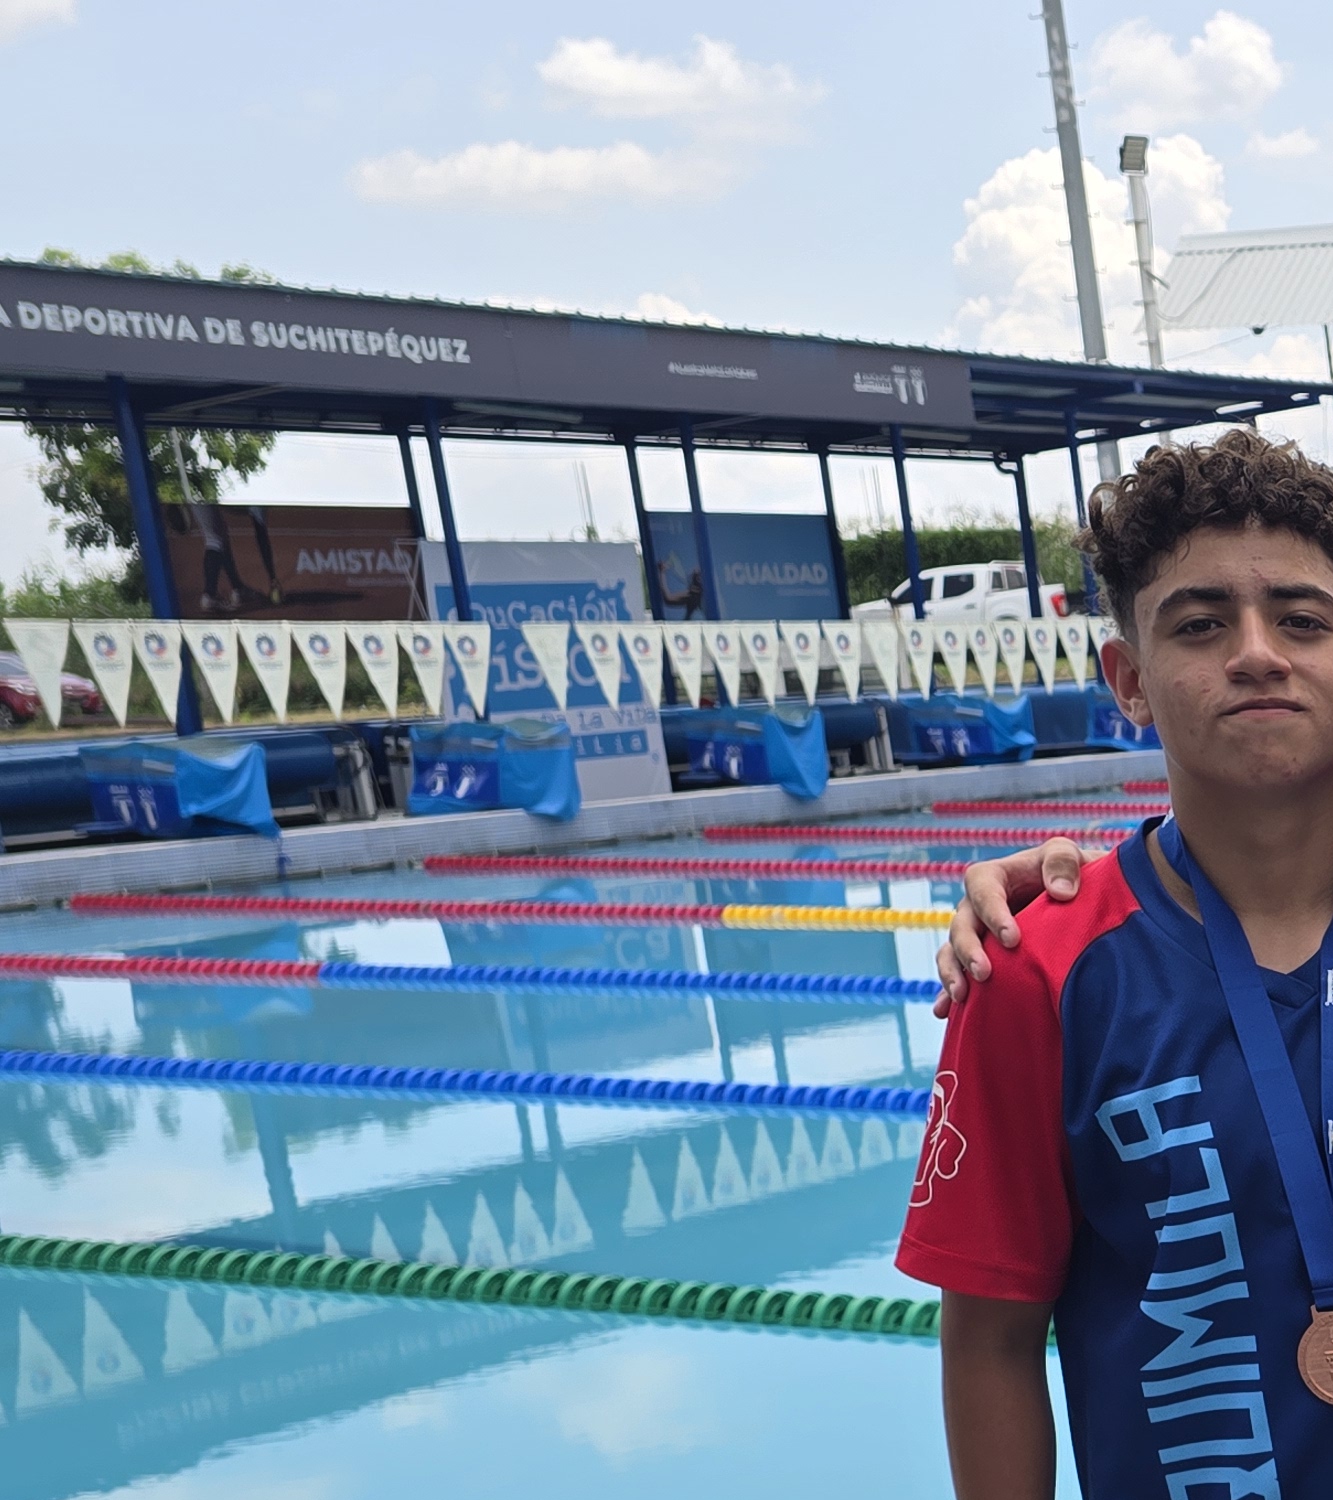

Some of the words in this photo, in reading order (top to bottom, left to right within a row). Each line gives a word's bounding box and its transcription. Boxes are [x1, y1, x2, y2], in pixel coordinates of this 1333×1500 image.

[17, 301, 200, 343] DEPORTIVA
[203, 316, 245, 346] DE
[250, 321, 471, 364] SUCHITEPÉQUEZ
[296, 548, 412, 575] AMISTAD
[723, 561, 828, 586] IGUALDAD
